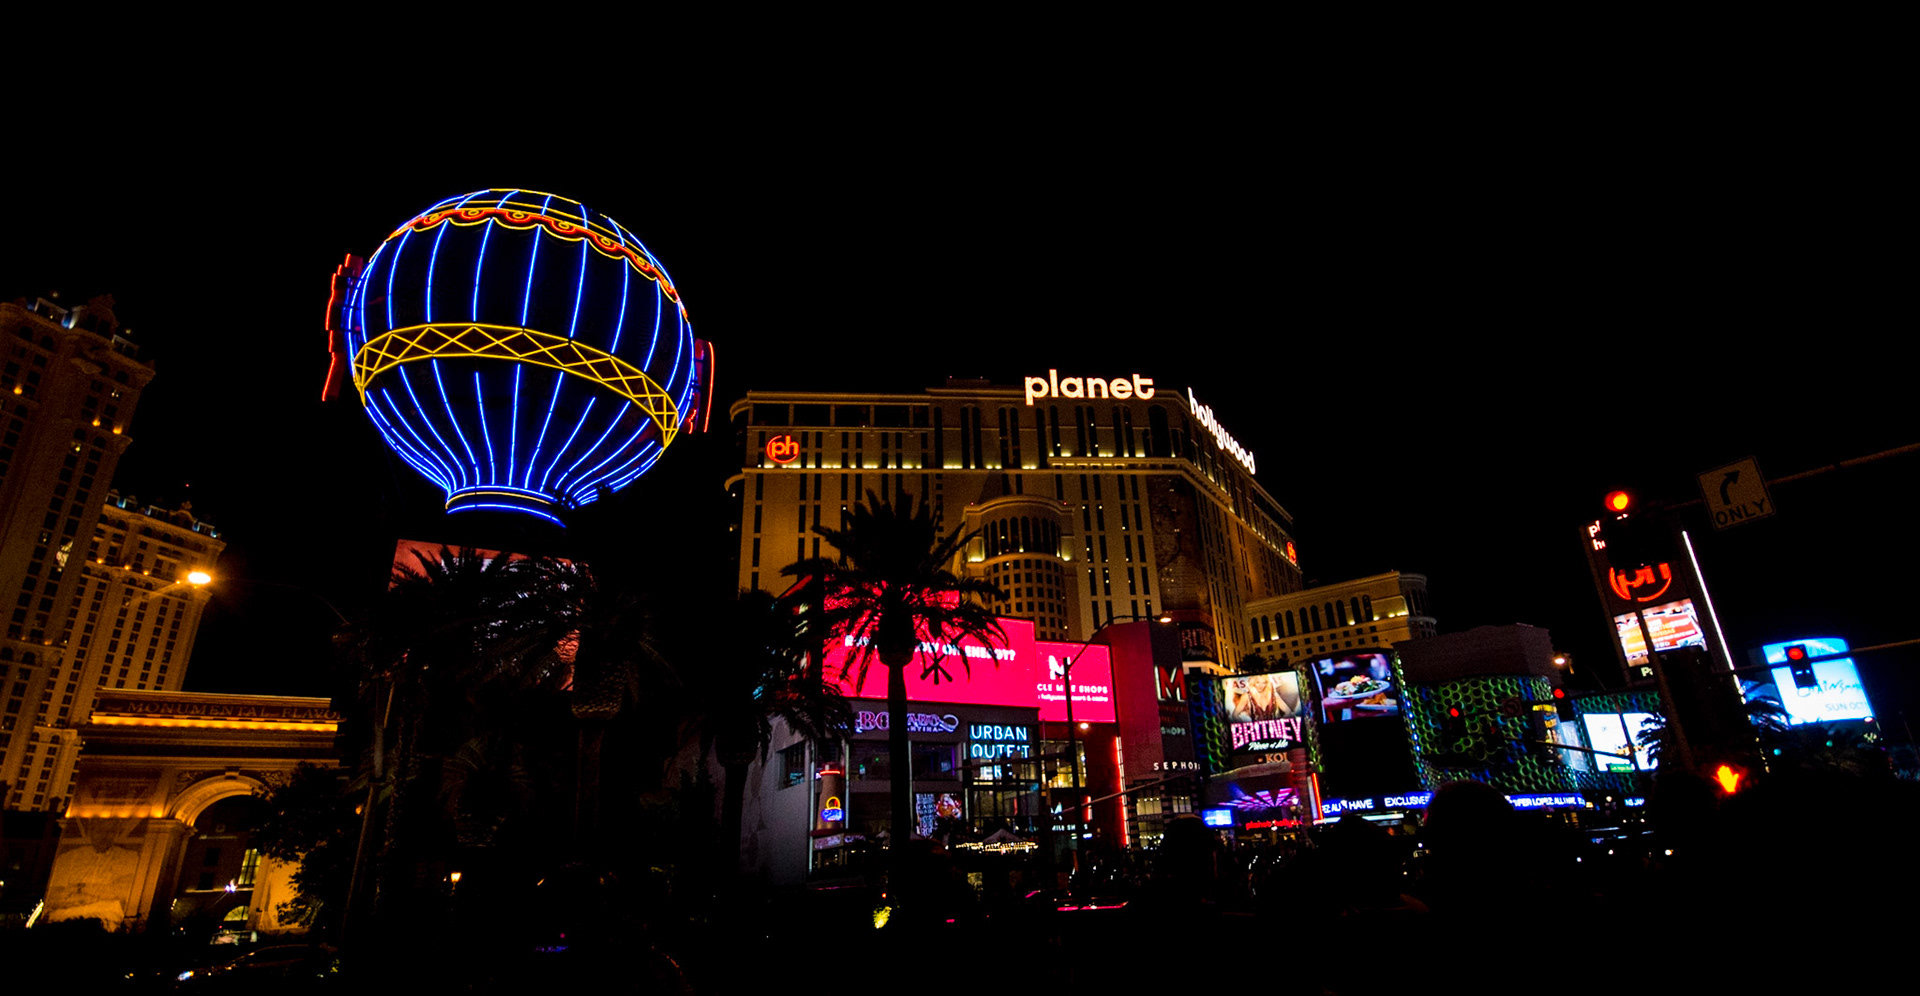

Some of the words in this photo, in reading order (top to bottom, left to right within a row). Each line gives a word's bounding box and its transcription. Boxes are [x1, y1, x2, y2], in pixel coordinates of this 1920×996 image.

[1025, 368, 1155, 406] planet
[1188, 386, 1256, 475] hollywood
[771, 434, 799, 458] ph
[1715, 497, 1765, 525] ONLY
[1079, 685, 1108, 694] SHOPS
[1154, 666, 1187, 702] M
[126, 700, 270, 718] MONUMENTAL
[970, 725, 1027, 741] URBAN
[1230, 716, 1302, 750] BRITNEY
[1266, 752, 1289, 764] KOI
[1349, 799, 1374, 810] HAVE
